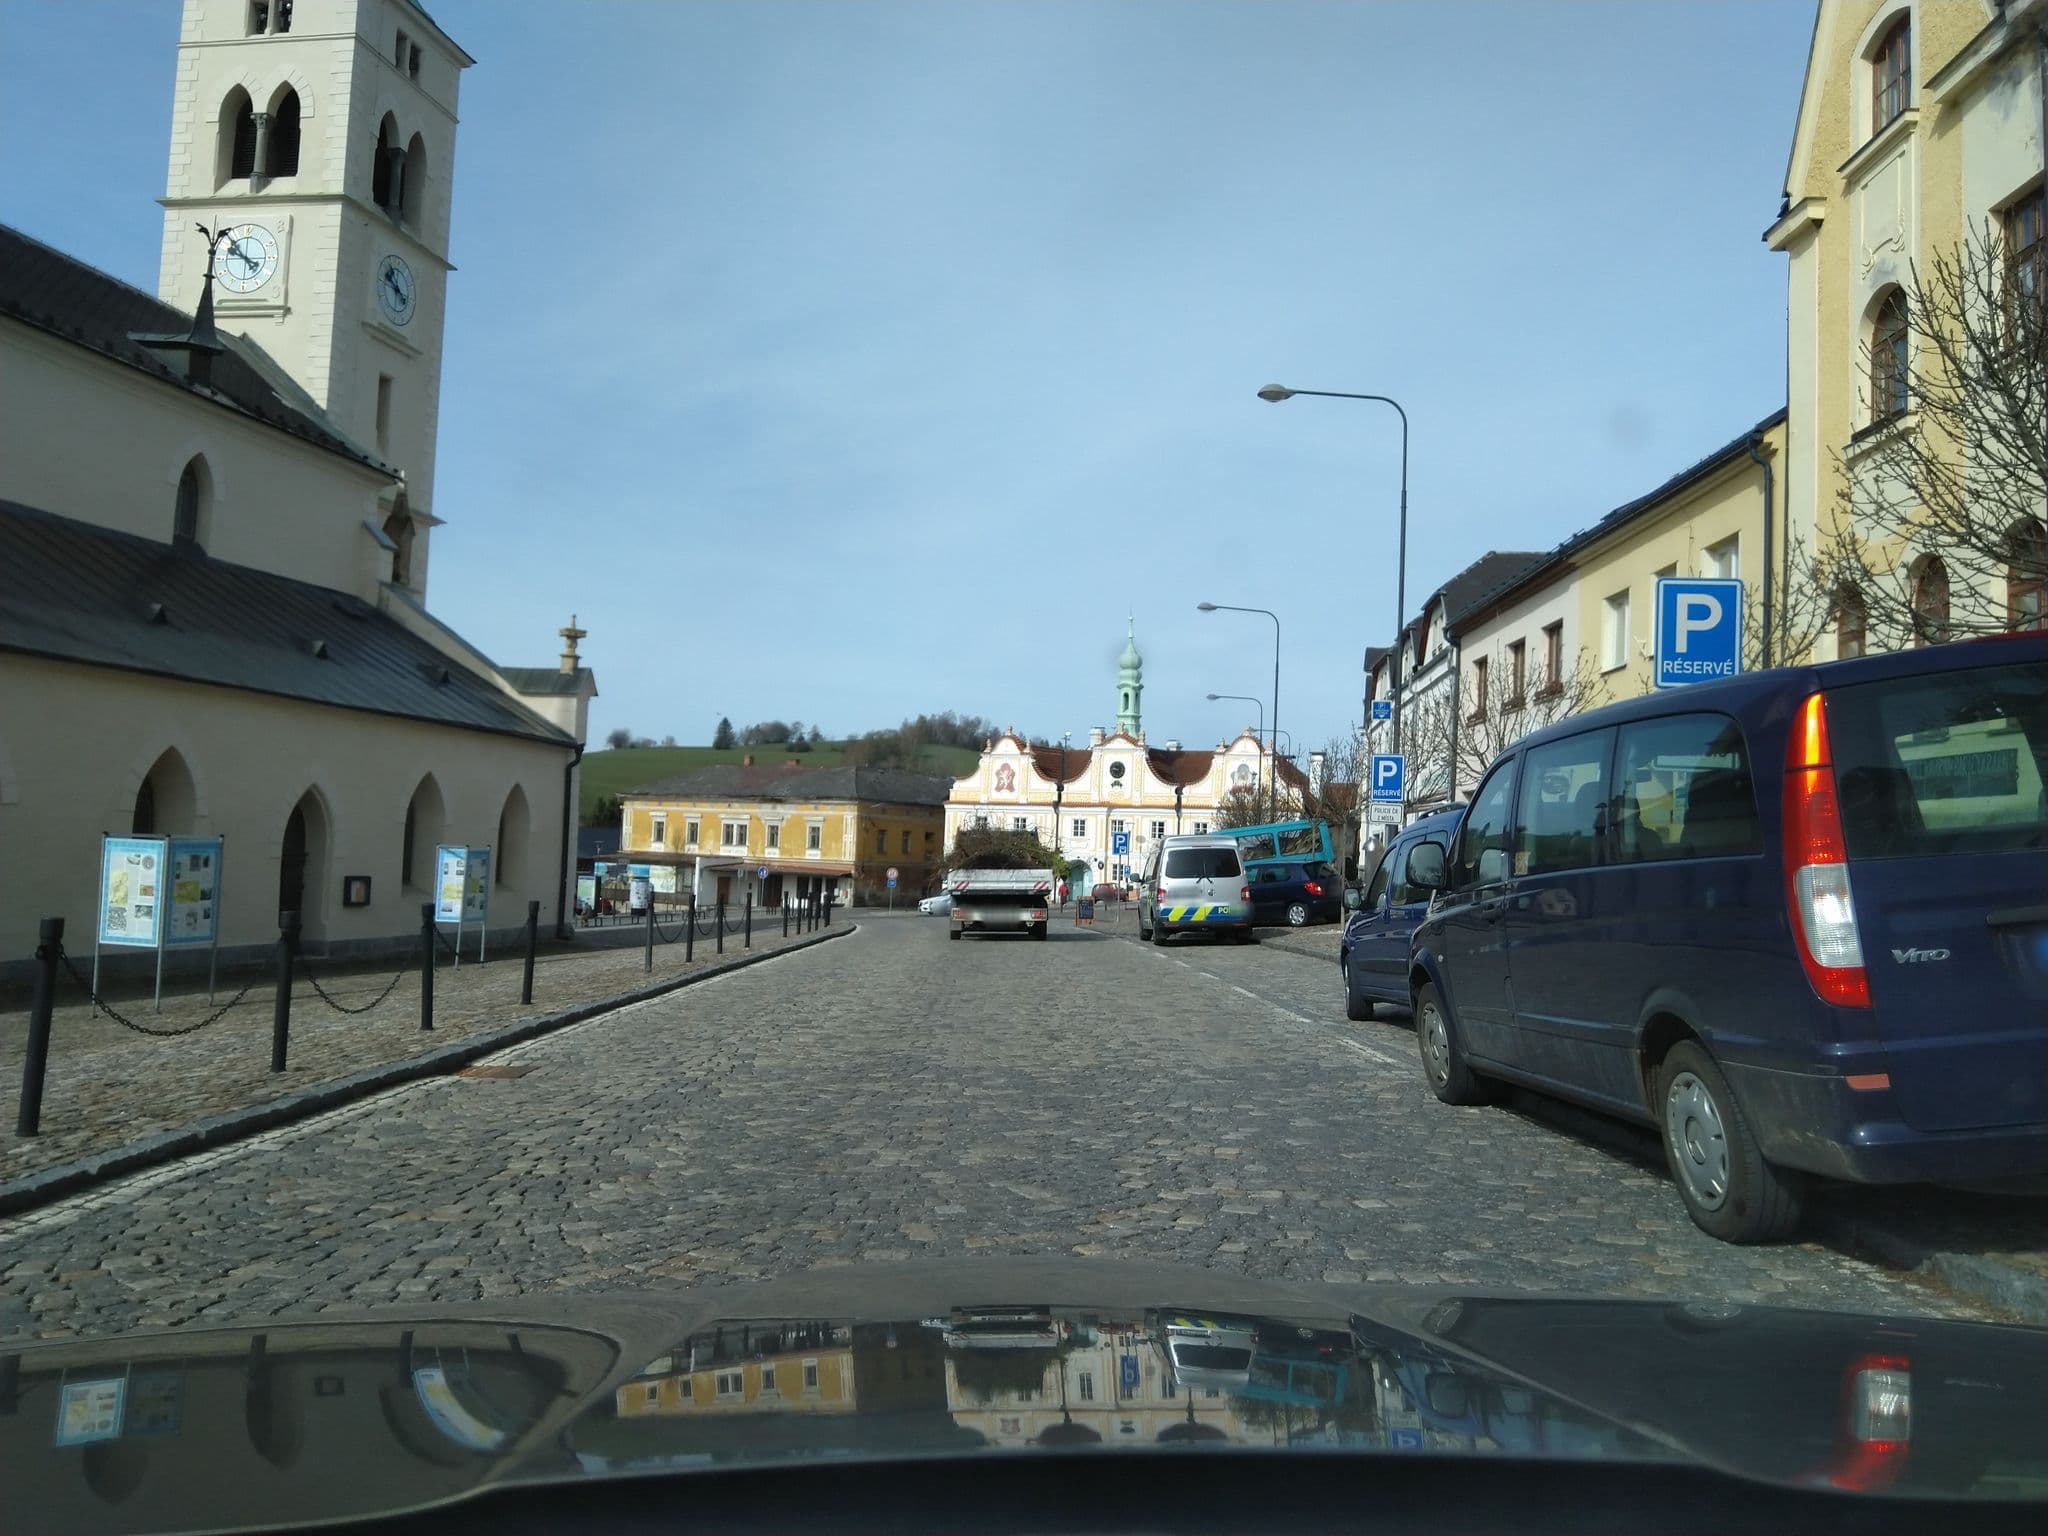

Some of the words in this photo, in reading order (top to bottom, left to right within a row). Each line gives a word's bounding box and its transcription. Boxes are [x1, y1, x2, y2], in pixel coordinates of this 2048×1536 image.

[1676, 593, 1722, 653] P
[1663, 657, 1733, 675] RÉSERVÉ
[1378, 760, 1398, 787] P
[1373, 788, 1401, 797] RÉSERVÉ
[1115, 834, 1126, 849] P
